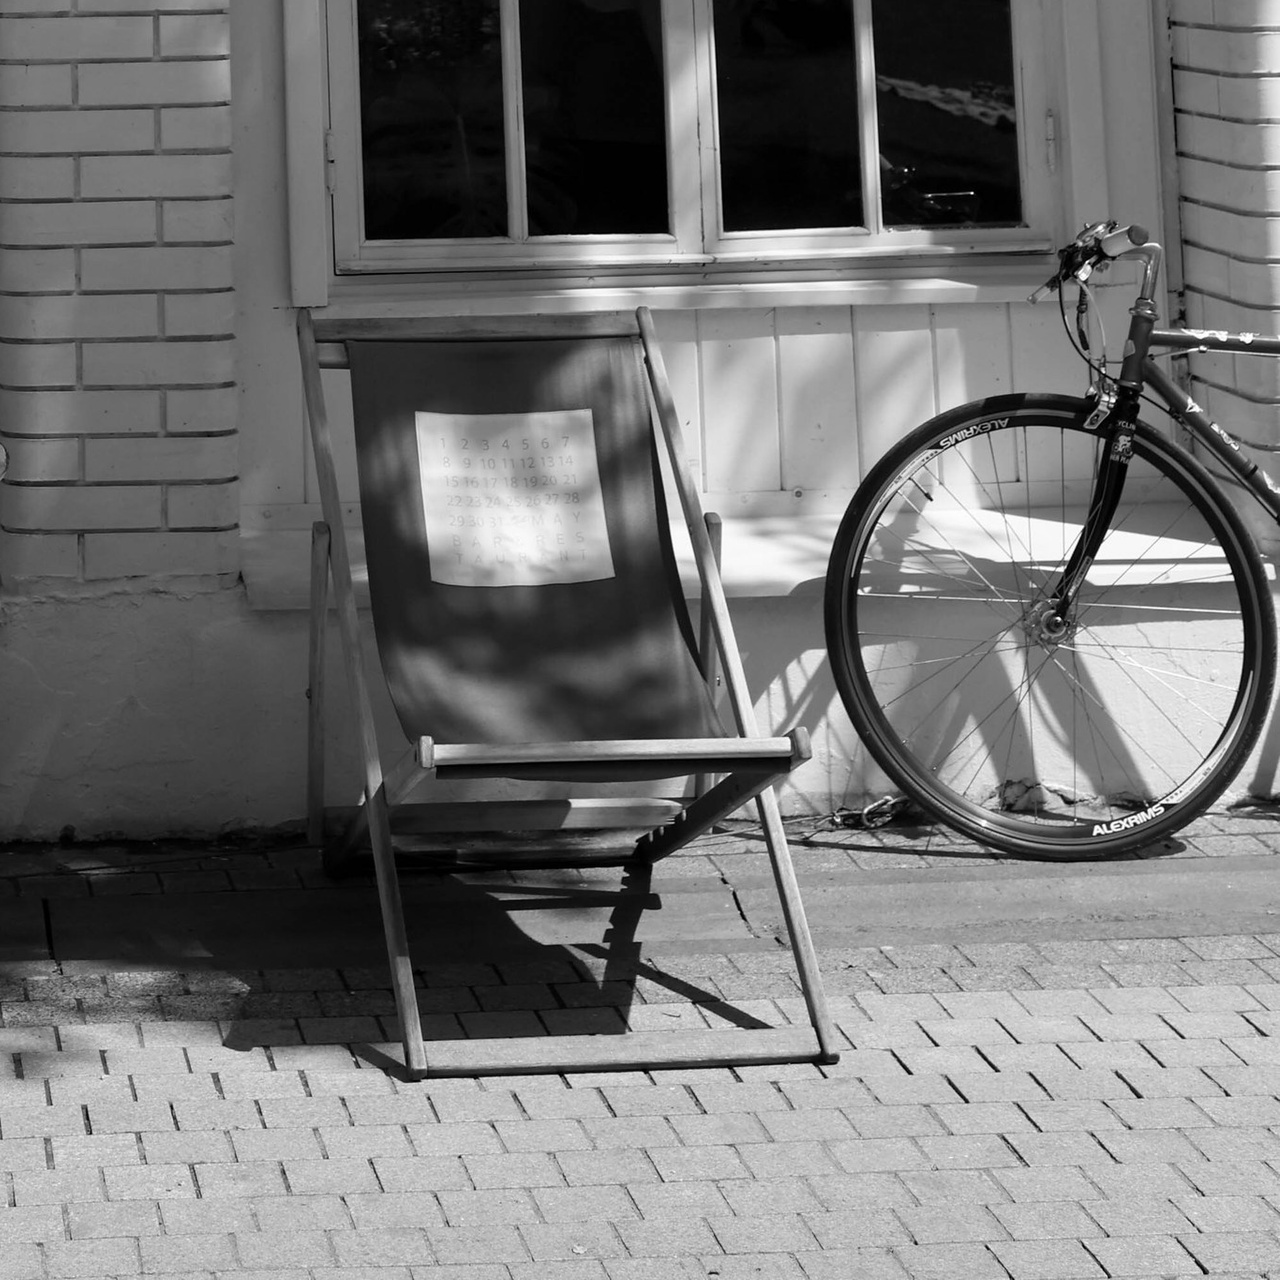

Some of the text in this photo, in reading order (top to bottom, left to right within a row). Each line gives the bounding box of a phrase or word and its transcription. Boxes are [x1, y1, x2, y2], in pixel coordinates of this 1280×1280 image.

[940, 418, 1009, 449] ALEXRIMS
[461, 439, 469, 449] 2
[482, 440, 490, 451] 3
[502, 439, 510, 450] 4
[522, 439, 530, 450] 5
[541, 438, 549, 449] 6
[562, 436, 570, 447] 7
[443, 455, 573, 470] 8 9 10 11 12 13 14
[445, 474, 577, 488] 15 16 17 18 19 20 21
[447, 492, 580, 508] 22 23 24 25 26 27 28
[449, 514, 465, 527] 29
[468, 515, 484, 527] 30
[1092, 803, 1165, 836] ALEXRIMS
